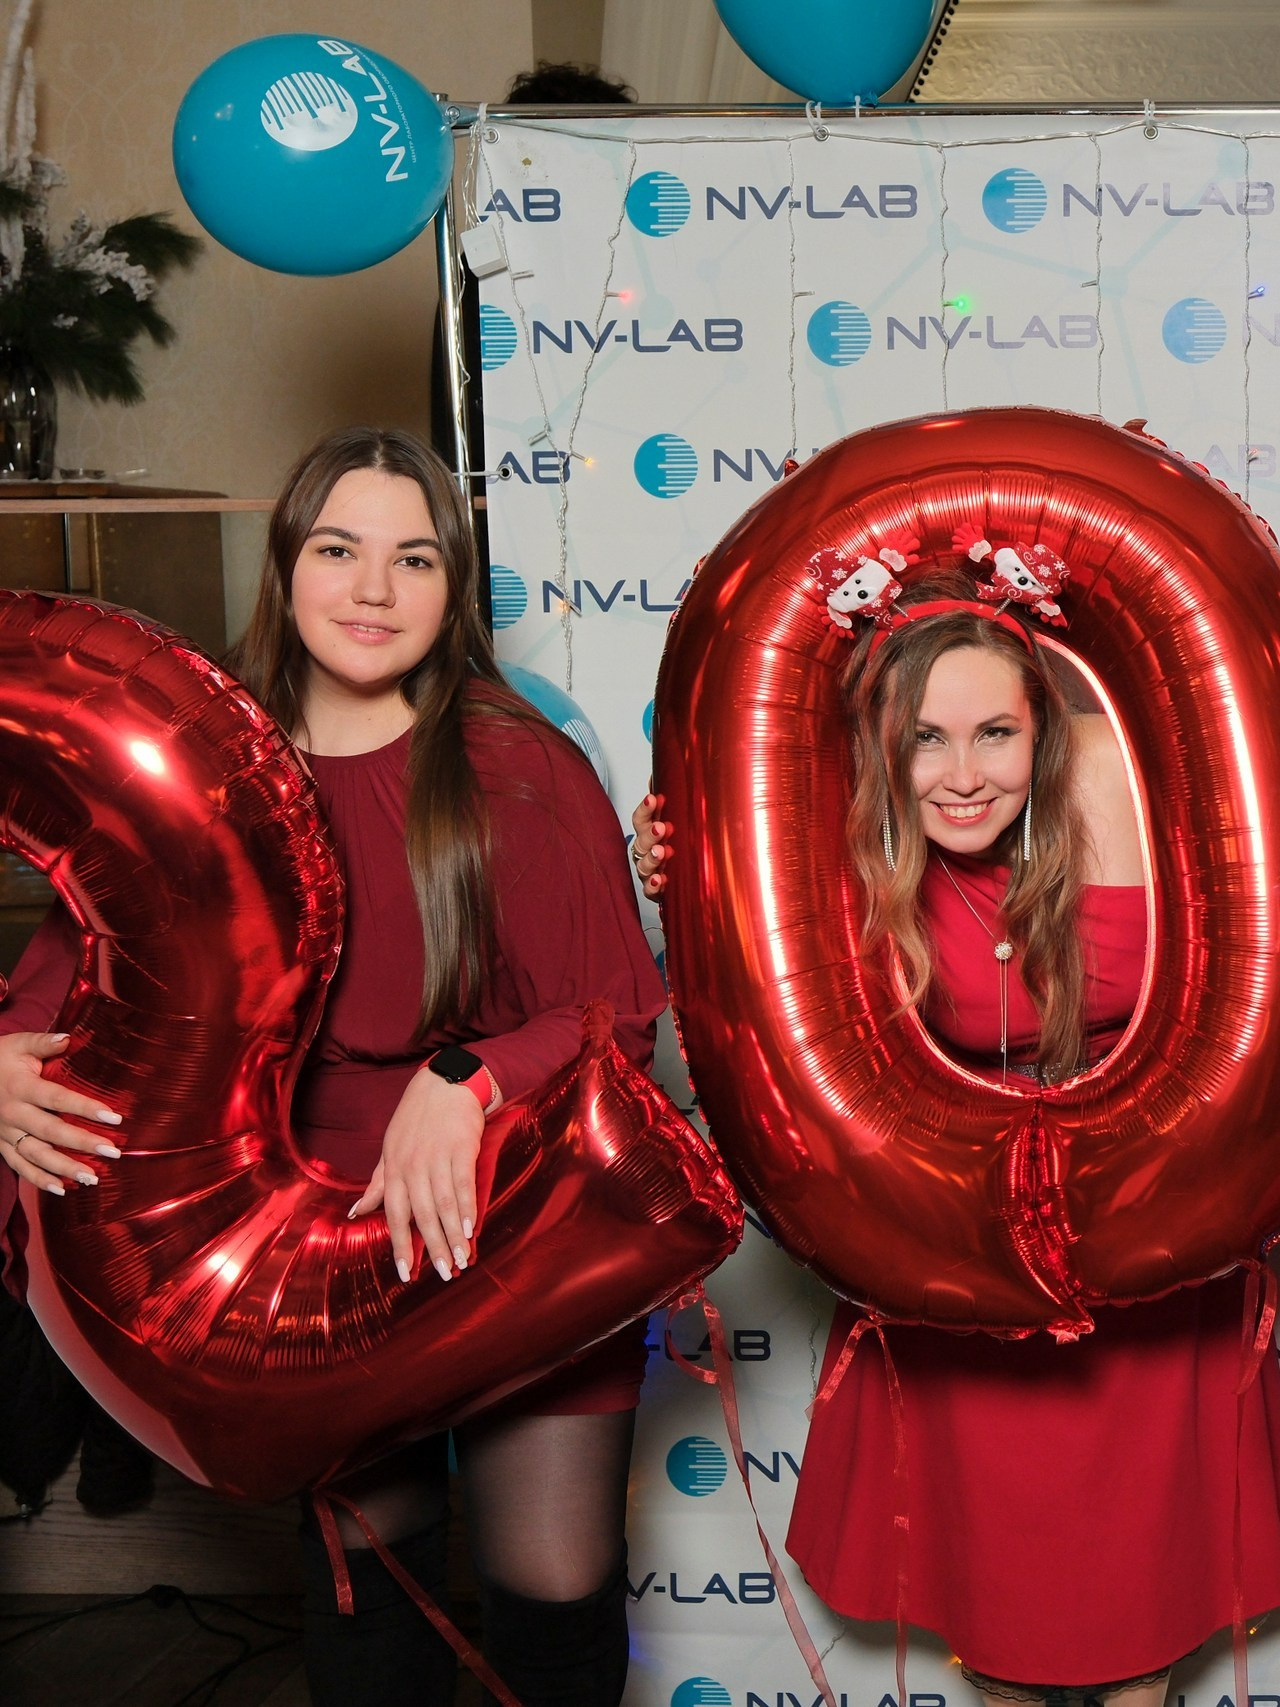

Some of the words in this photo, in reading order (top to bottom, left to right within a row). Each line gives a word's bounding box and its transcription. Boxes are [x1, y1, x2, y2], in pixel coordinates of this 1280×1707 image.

[317, 40, 408, 182] NV-LAB
[706, 185, 918, 220] NV-LAB
[1063, 182, 1275, 217] NV-LAB
[532, 318, 743, 354] NV-LAB
[887, 314, 1098, 350] NV-LAB
[627, 1572, 775, 1604] V-LAB
